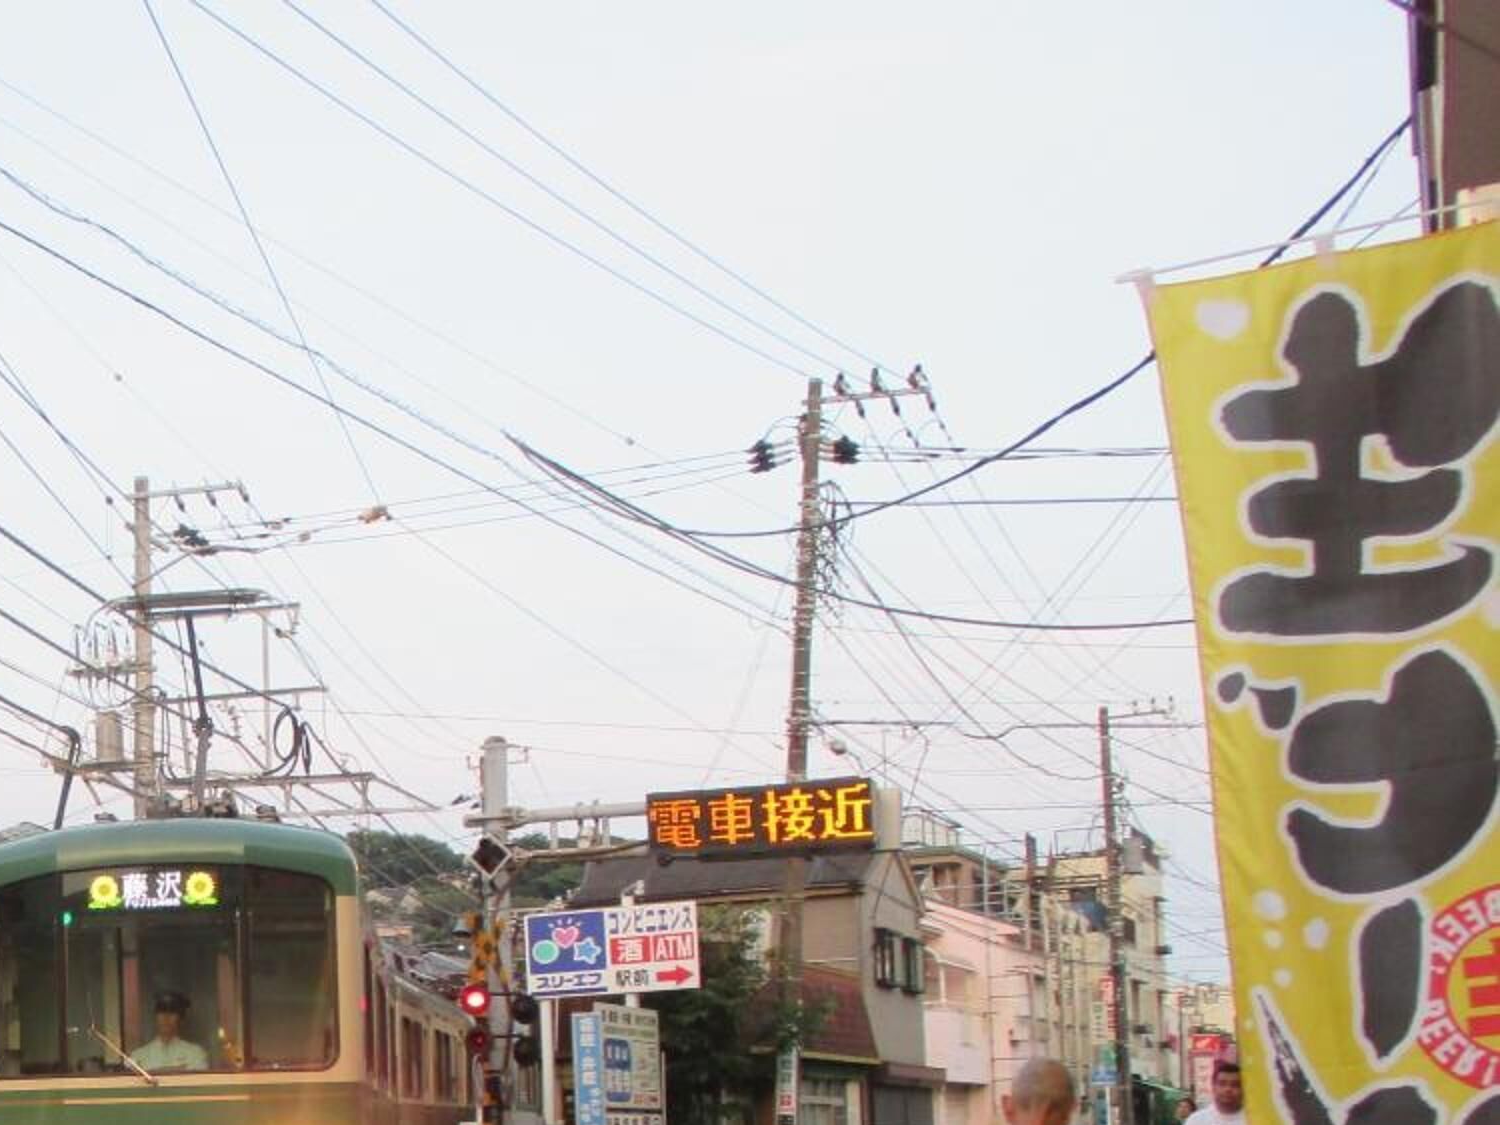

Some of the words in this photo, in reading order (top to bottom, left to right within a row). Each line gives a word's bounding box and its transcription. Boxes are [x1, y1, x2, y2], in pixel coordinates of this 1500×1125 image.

[651, 782, 875, 848] 電車接近
[121, 871, 182, 899] 藤沢
[608, 904, 693, 934] コンビニエンス
[617, 938, 645, 962] 酒
[654, 933, 693, 961] ATM
[615, 969, 649, 987] 駅前
